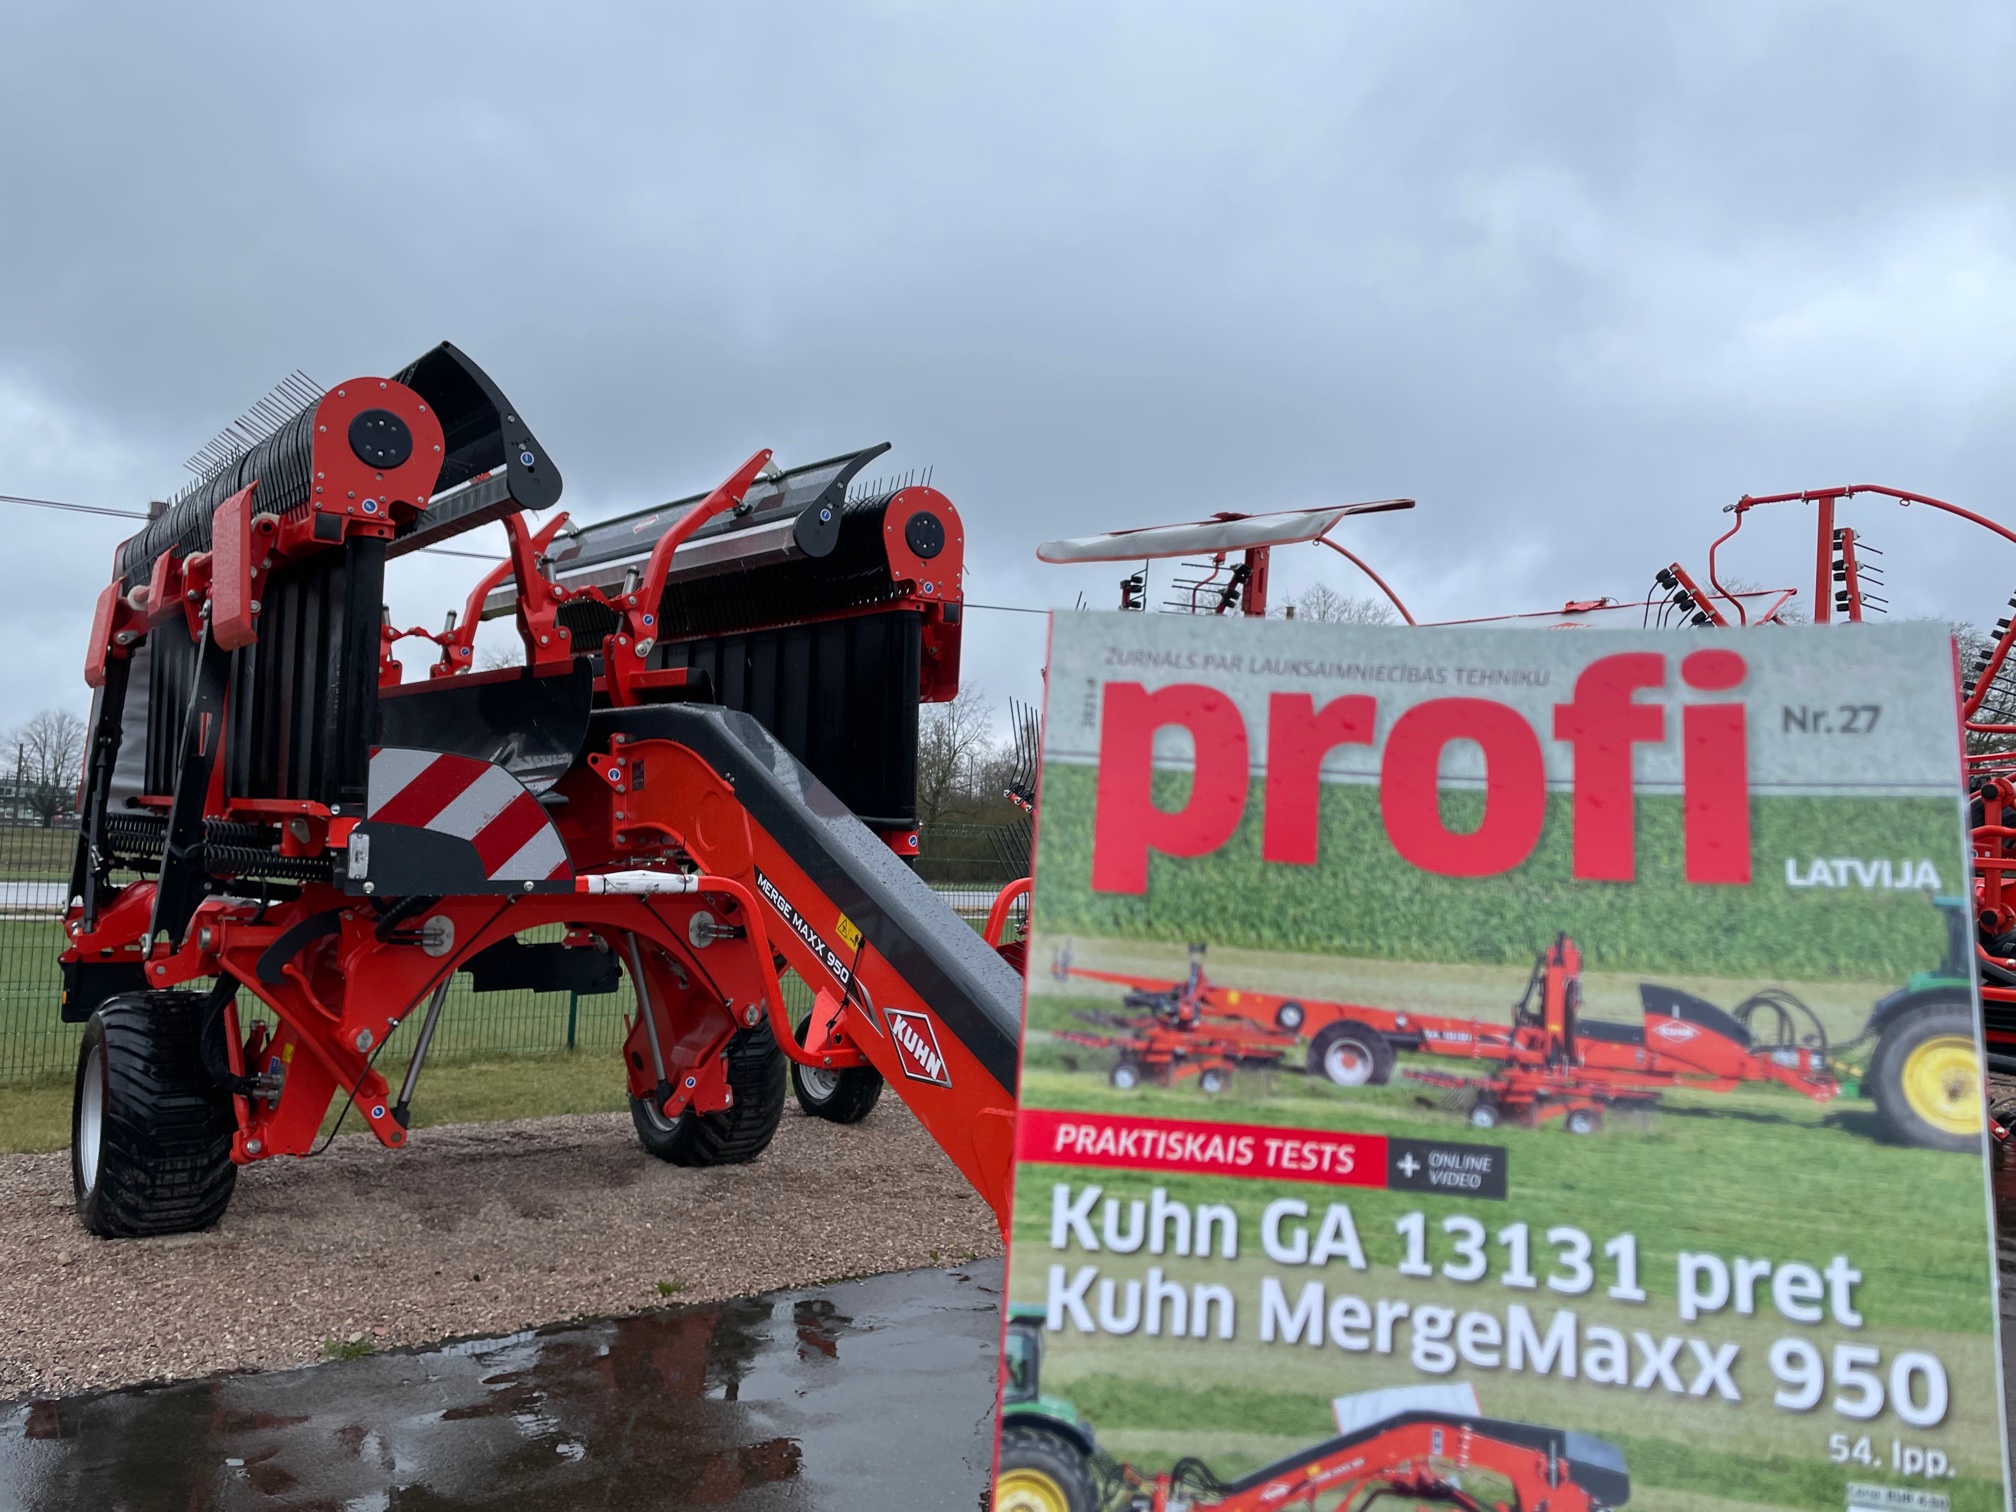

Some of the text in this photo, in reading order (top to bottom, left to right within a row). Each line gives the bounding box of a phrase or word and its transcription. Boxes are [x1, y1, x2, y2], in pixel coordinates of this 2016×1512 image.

[1203, 653, 1244, 673] PAR
[1455, 667, 1551, 687] TEHNIKU
[1091, 648, 1751, 895] profi
[1786, 858, 1942, 889] LATVIJA
[757, 873, 849, 984] MERGE MAXX 950
[891, 1014, 942, 1081] KUHN
[1055, 1123, 1356, 1174] PRAKTISKAIS TESTS
[1428, 1150, 1492, 1172] ONLINE
[1429, 1170, 1482, 1189] VIDEO
[1050, 1182, 1864, 1328] Kuhn GA 13131 pret
[1046, 1263, 1950, 1428] Kuhn MergeMaxx 950
[1829, 1433, 1957, 1479] 54. lpp.
